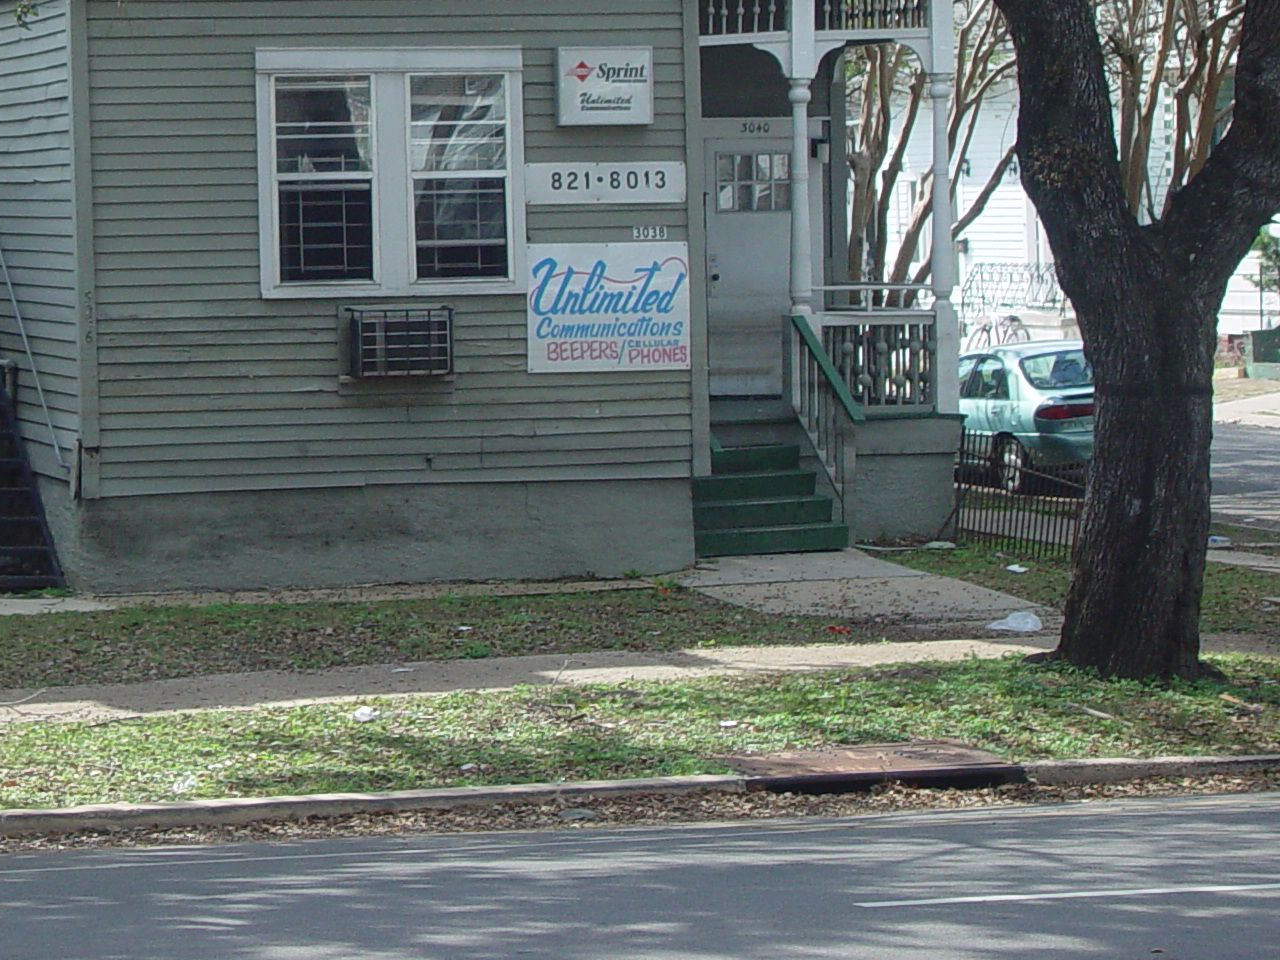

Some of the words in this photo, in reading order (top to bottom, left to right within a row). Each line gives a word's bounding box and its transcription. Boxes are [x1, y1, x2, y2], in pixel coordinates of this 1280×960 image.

[596, 63, 646, 82] Sprint
[578, 92, 633, 105] Unlimited
[635, 227, 665, 238] 3038
[532, 257, 687, 316] Unlimited
[536, 316, 684, 339] Communications
[628, 339, 680, 348] CELLULAR
[628, 346, 687, 364] PHONES
